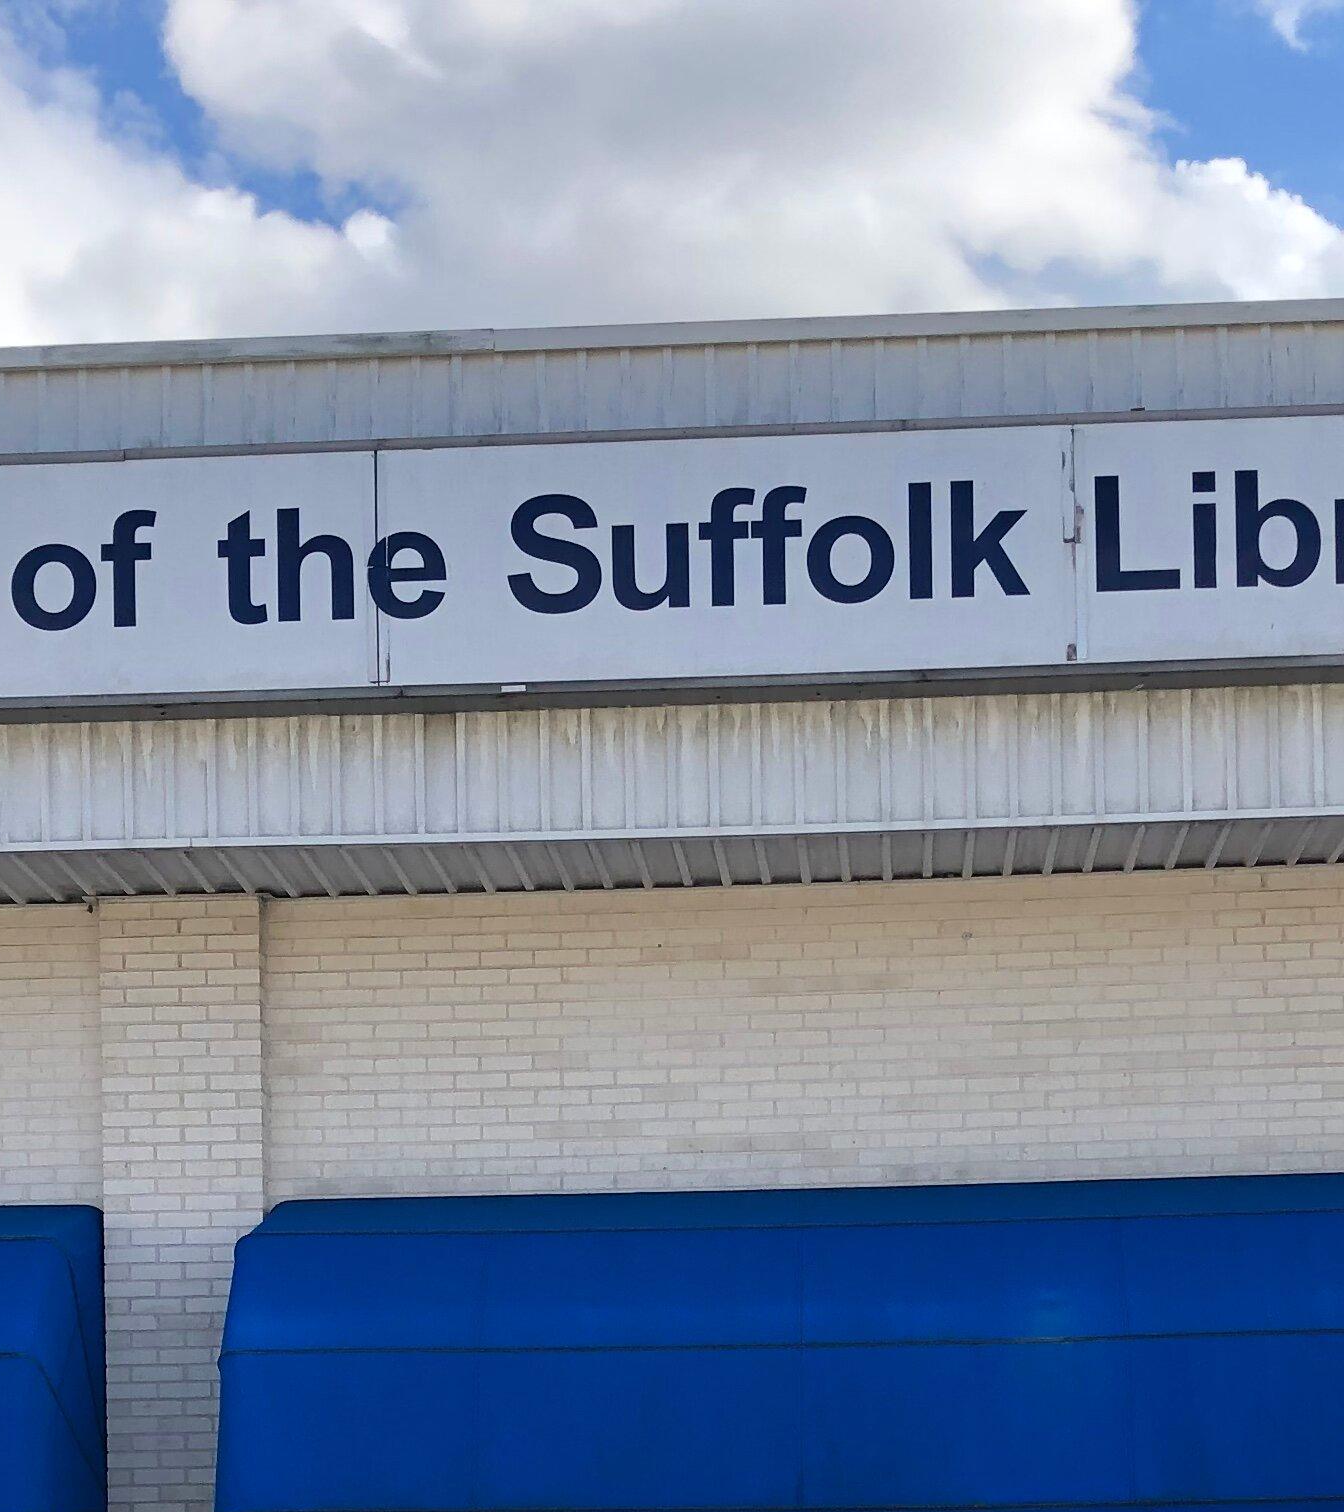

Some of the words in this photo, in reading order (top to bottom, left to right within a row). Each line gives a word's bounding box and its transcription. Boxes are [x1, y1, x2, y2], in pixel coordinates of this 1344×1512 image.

[10, 509, 159, 632] of
[218, 506, 448, 625] the
[506, 479, 1032, 615] Suffolk
